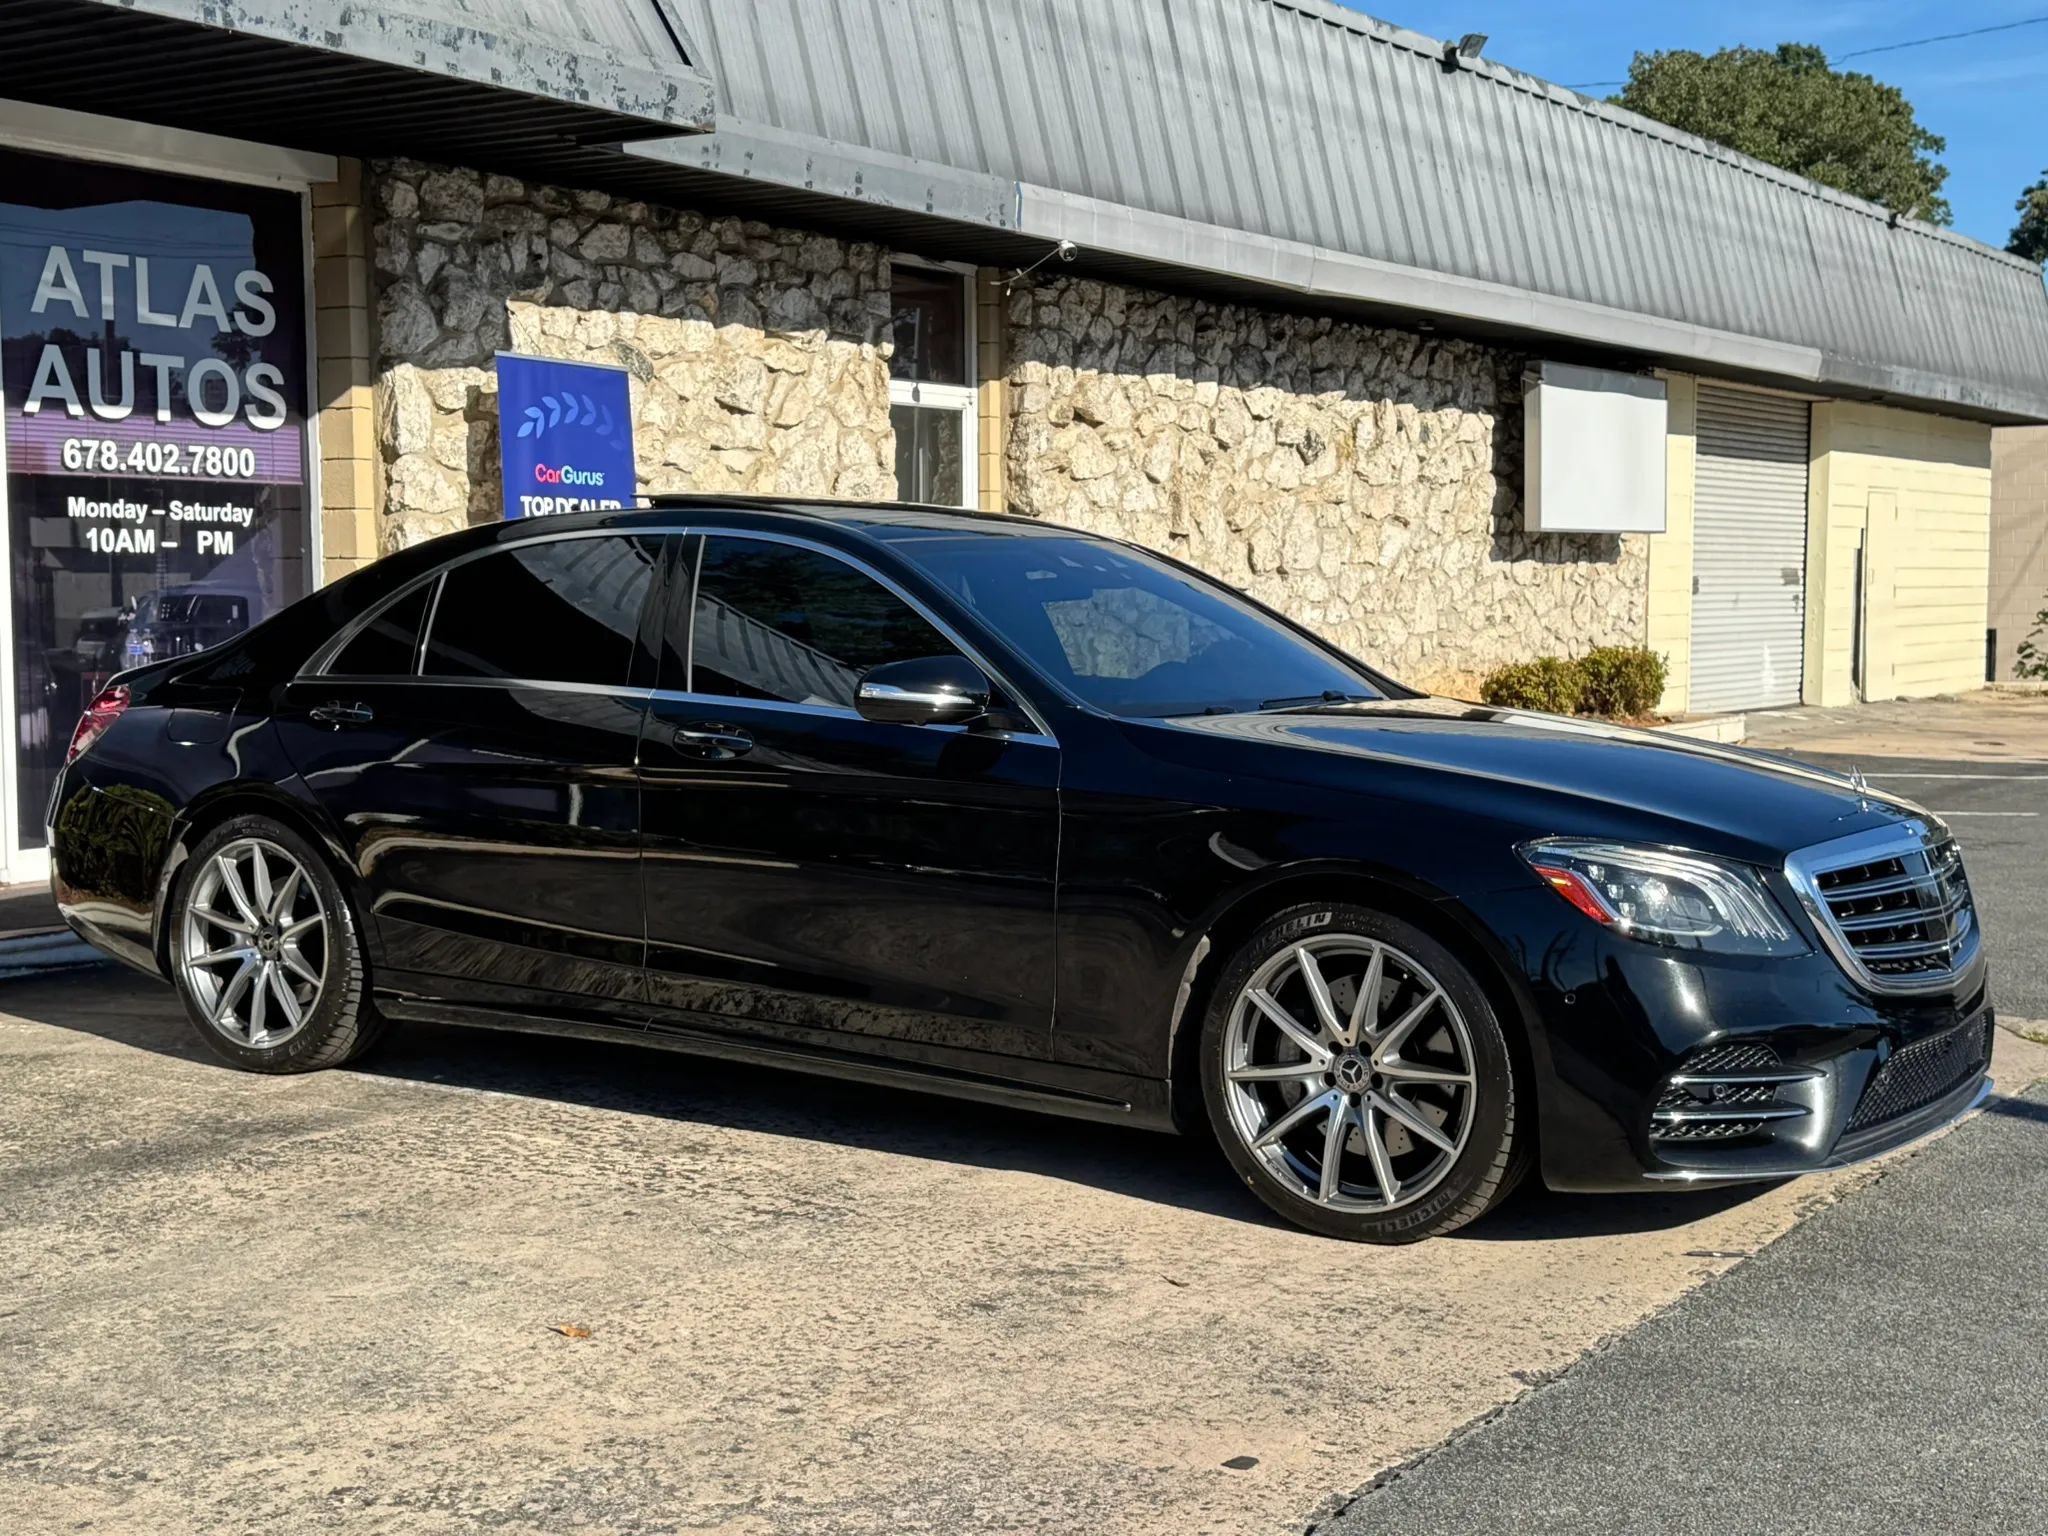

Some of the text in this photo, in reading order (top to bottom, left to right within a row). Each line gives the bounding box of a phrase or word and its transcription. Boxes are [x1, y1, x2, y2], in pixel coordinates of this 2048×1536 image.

[30, 245, 277, 338] ATLAS
[23, 343, 288, 431] AUTOS
[63, 438, 256, 477] 678.402.7800
[535, 463, 605, 486] CarGurus
[67, 496, 149, 524] Monday
[169, 500, 254, 528] Saturday
[520, 495, 554, 517] TOP
[86, 527, 156, 554] 10AM
[197, 530, 234, 555] PM
